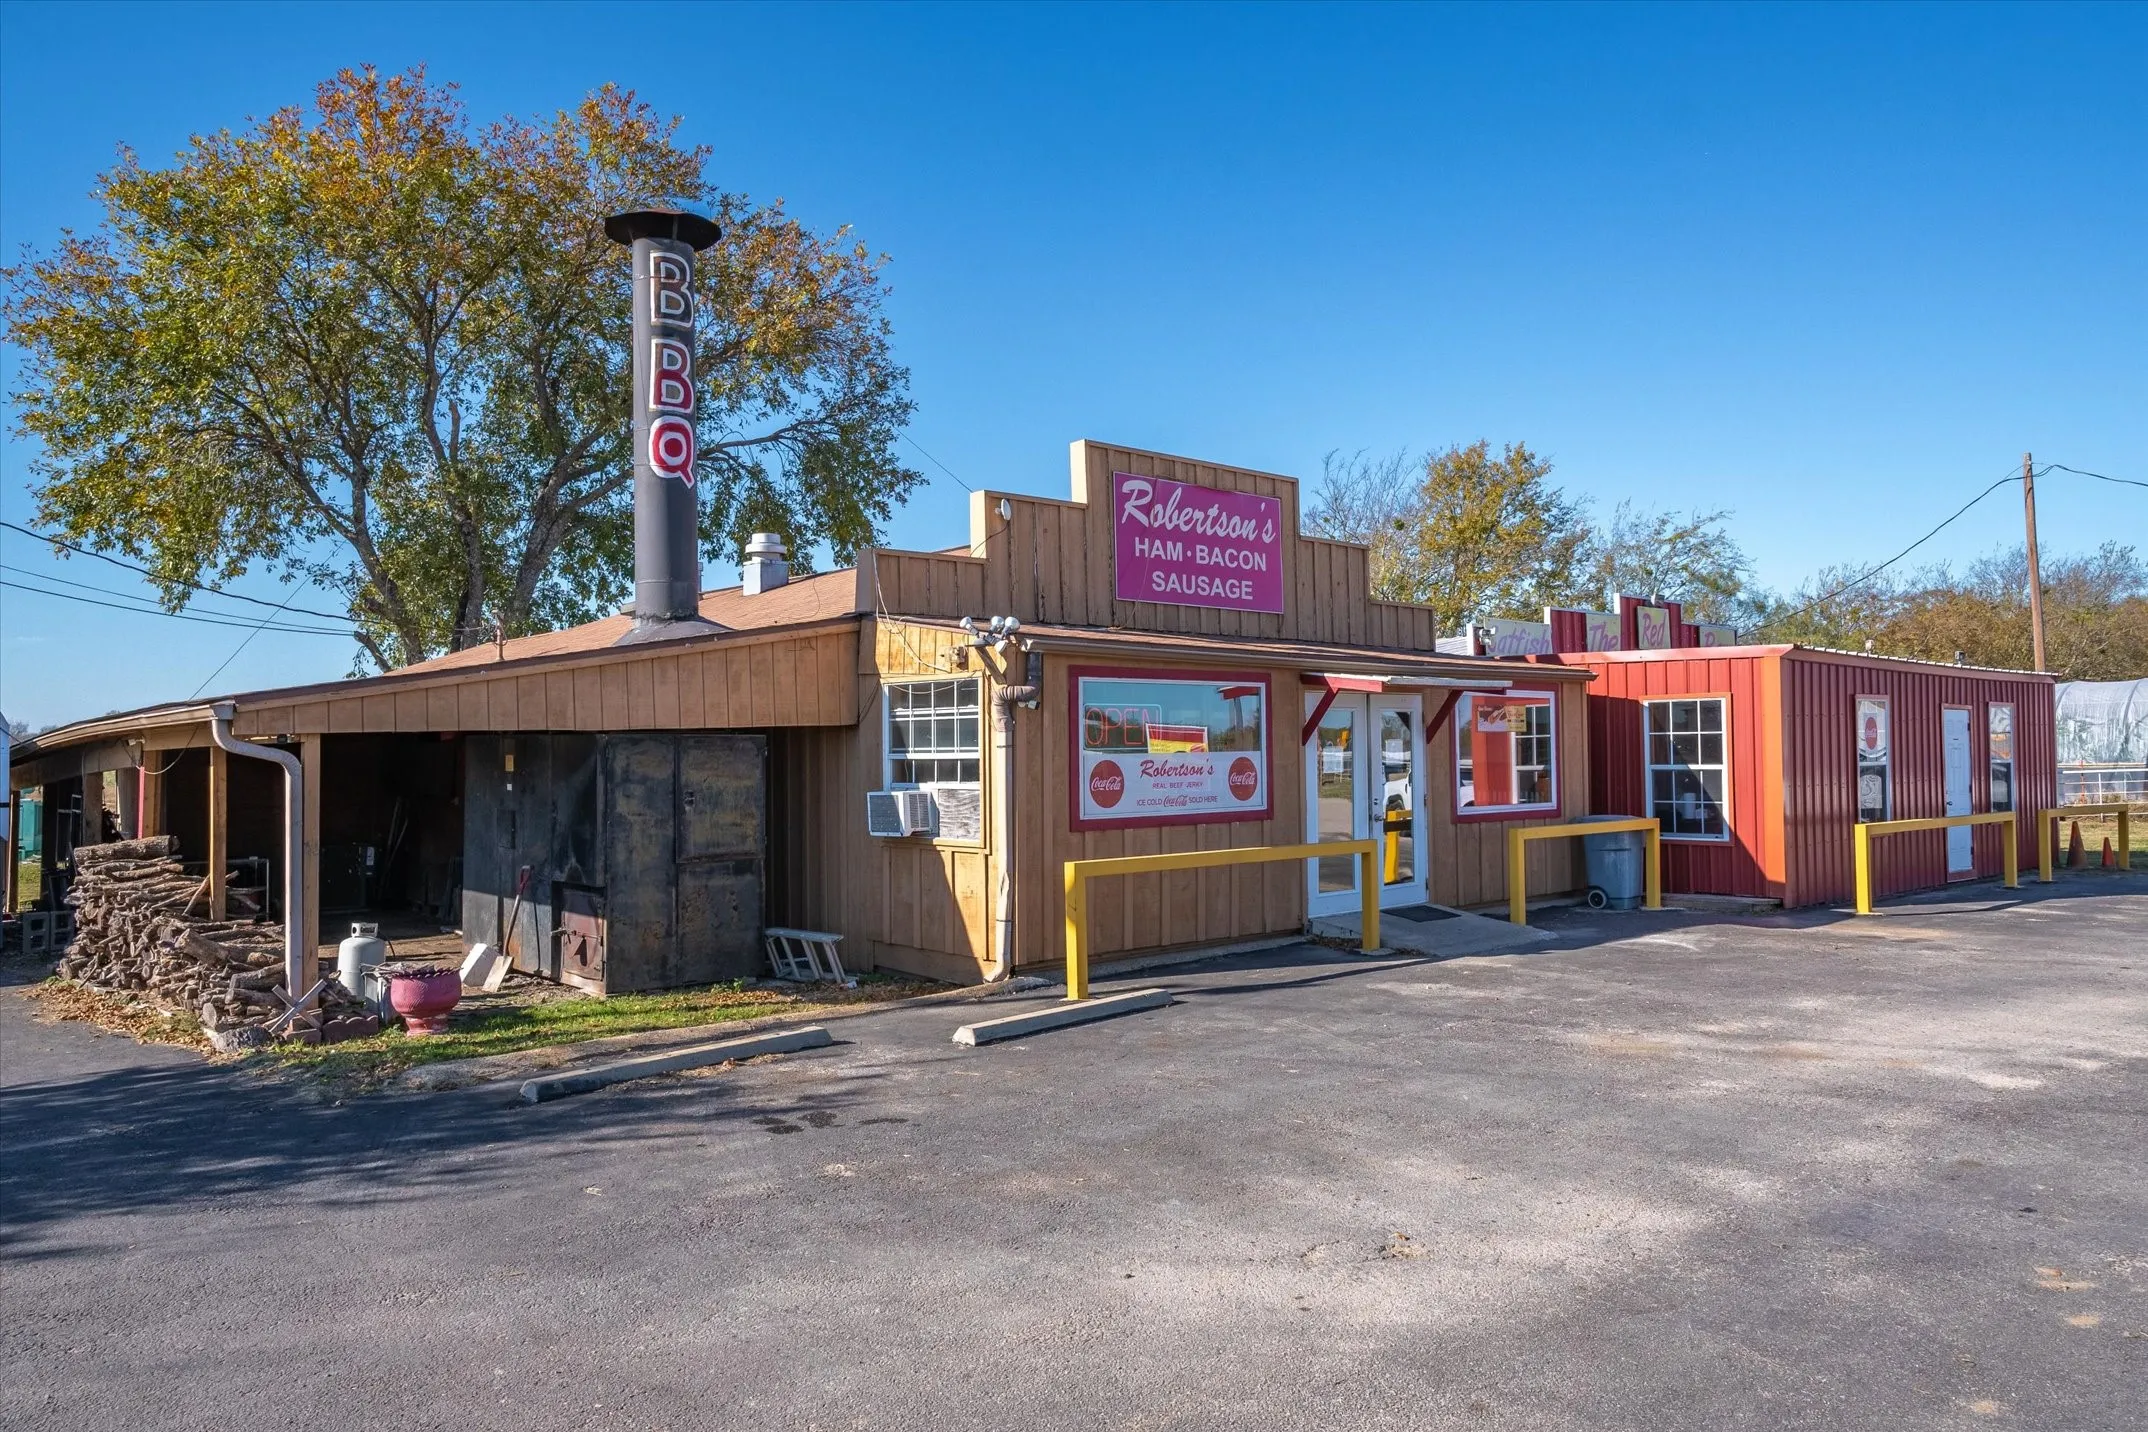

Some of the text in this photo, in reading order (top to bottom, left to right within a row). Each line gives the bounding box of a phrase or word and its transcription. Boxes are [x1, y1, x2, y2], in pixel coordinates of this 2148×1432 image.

[649, 250, 695, 489] BBQ
[1121, 479, 1276, 544] Robertson's
[1134, 536, 1267, 572] HAM BACON
[1151, 570, 1253, 600] SAUSAGE
[1589, 621, 1619, 651] The
[1642, 611, 1667, 647] Red
[1085, 707, 1159, 745] OPEN
[1140, 757, 1215, 779] Robertson's
[1147, 798, 1162, 806] COLD
[1189, 796, 1203, 804] SOLD
[1203, 795, 1218, 803] HERE
